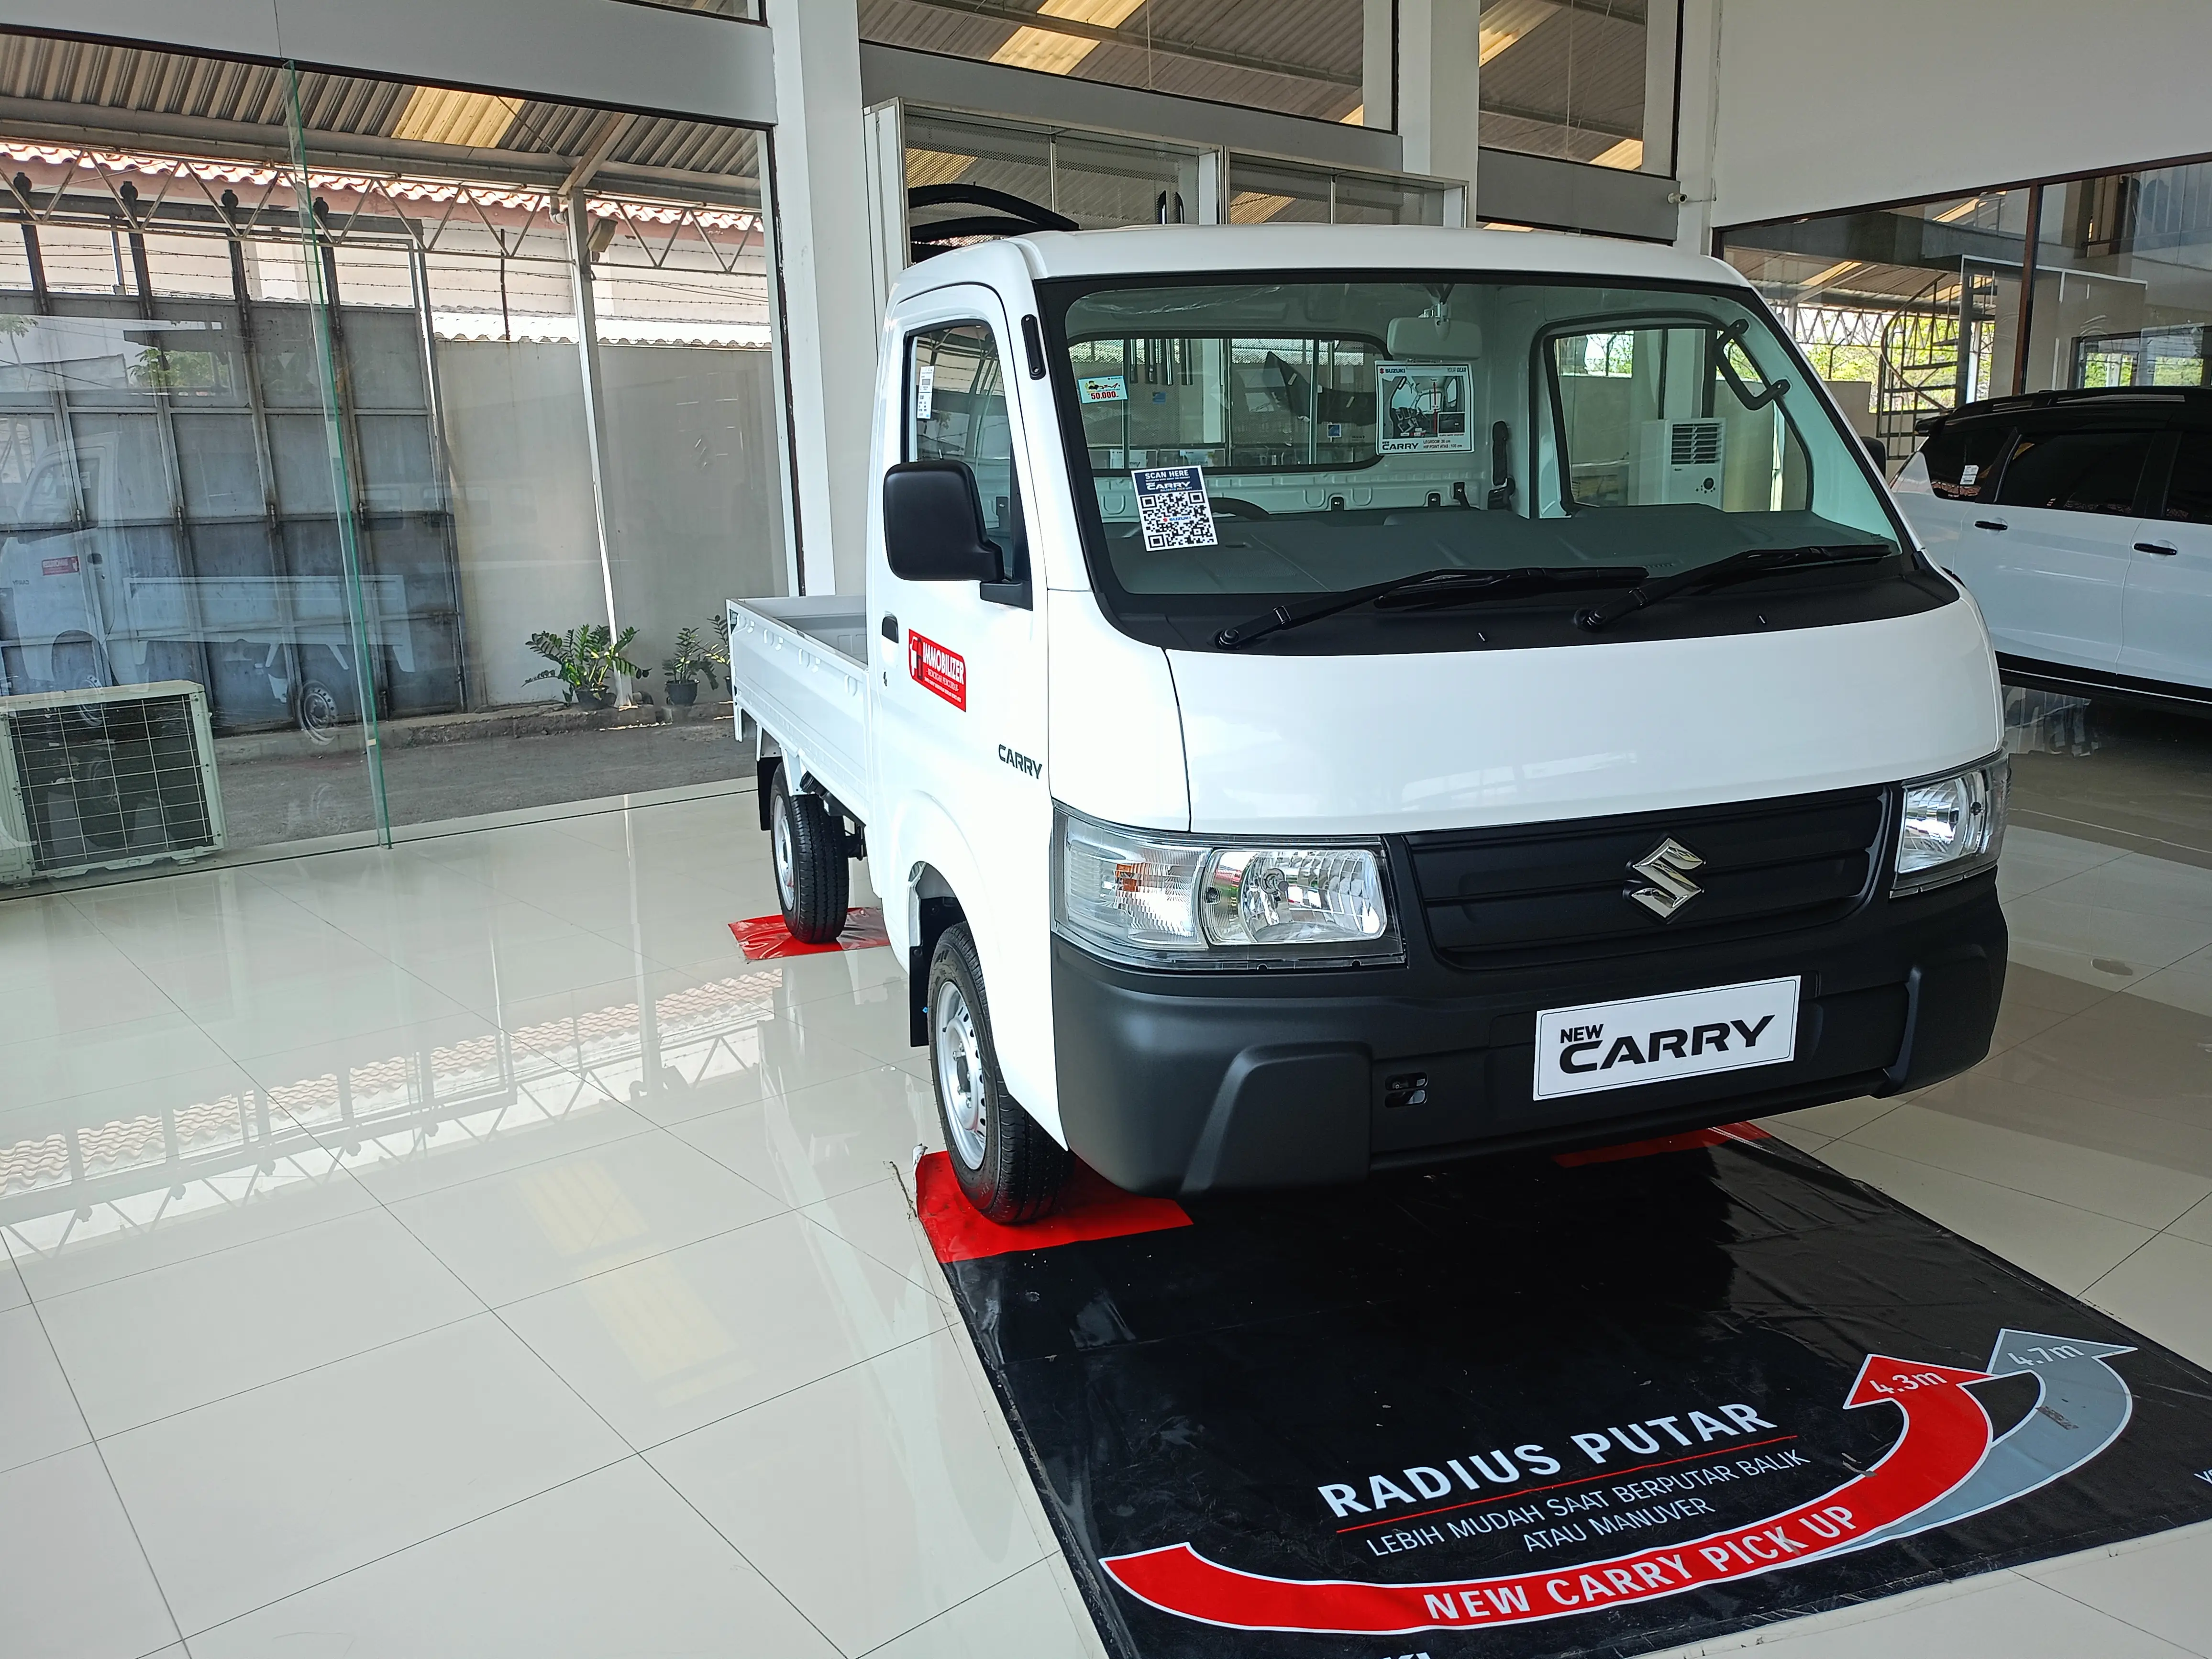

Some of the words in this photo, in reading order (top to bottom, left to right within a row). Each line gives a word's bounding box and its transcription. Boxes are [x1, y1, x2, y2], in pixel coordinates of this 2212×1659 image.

[1145, 471, 1167, 479] SCAN
[1169, 469, 1189, 477] HERE
[1147, 481, 1191, 490] CARRY
[923, 642, 964, 685] IMMOBILIZER
[998, 744, 1043, 780] CARRY
[1559, 1014, 1776, 1074] CARRY
[1560, 1023, 1604, 1044] NEW
[2007, 1343, 2085, 1366] 4.7m
[1869, 1370, 1947, 1394] 4.3m
[1317, 1444, 1561, 1518] RADIUS
[1570, 1403, 1778, 1464] PUTAR
[1366, 1526, 1445, 1557] LEBIH
[1446, 1504, 1546, 1539] MUDAH
[1547, 1491, 1609, 1516] SAAT
[1611, 1465, 1740, 1503] BERPUTAR
[1735, 1449, 1811, 1476] BALIK
[1523, 1524, 1587, 1552] ATAU
[1587, 1497, 1716, 1536] MANUVER
[1423, 1585, 1531, 1620] NEW
[1546, 1554, 1692, 1606] CARRY
[1698, 1525, 1809, 1572] PICK
[1798, 1506, 1857, 1538] UP
